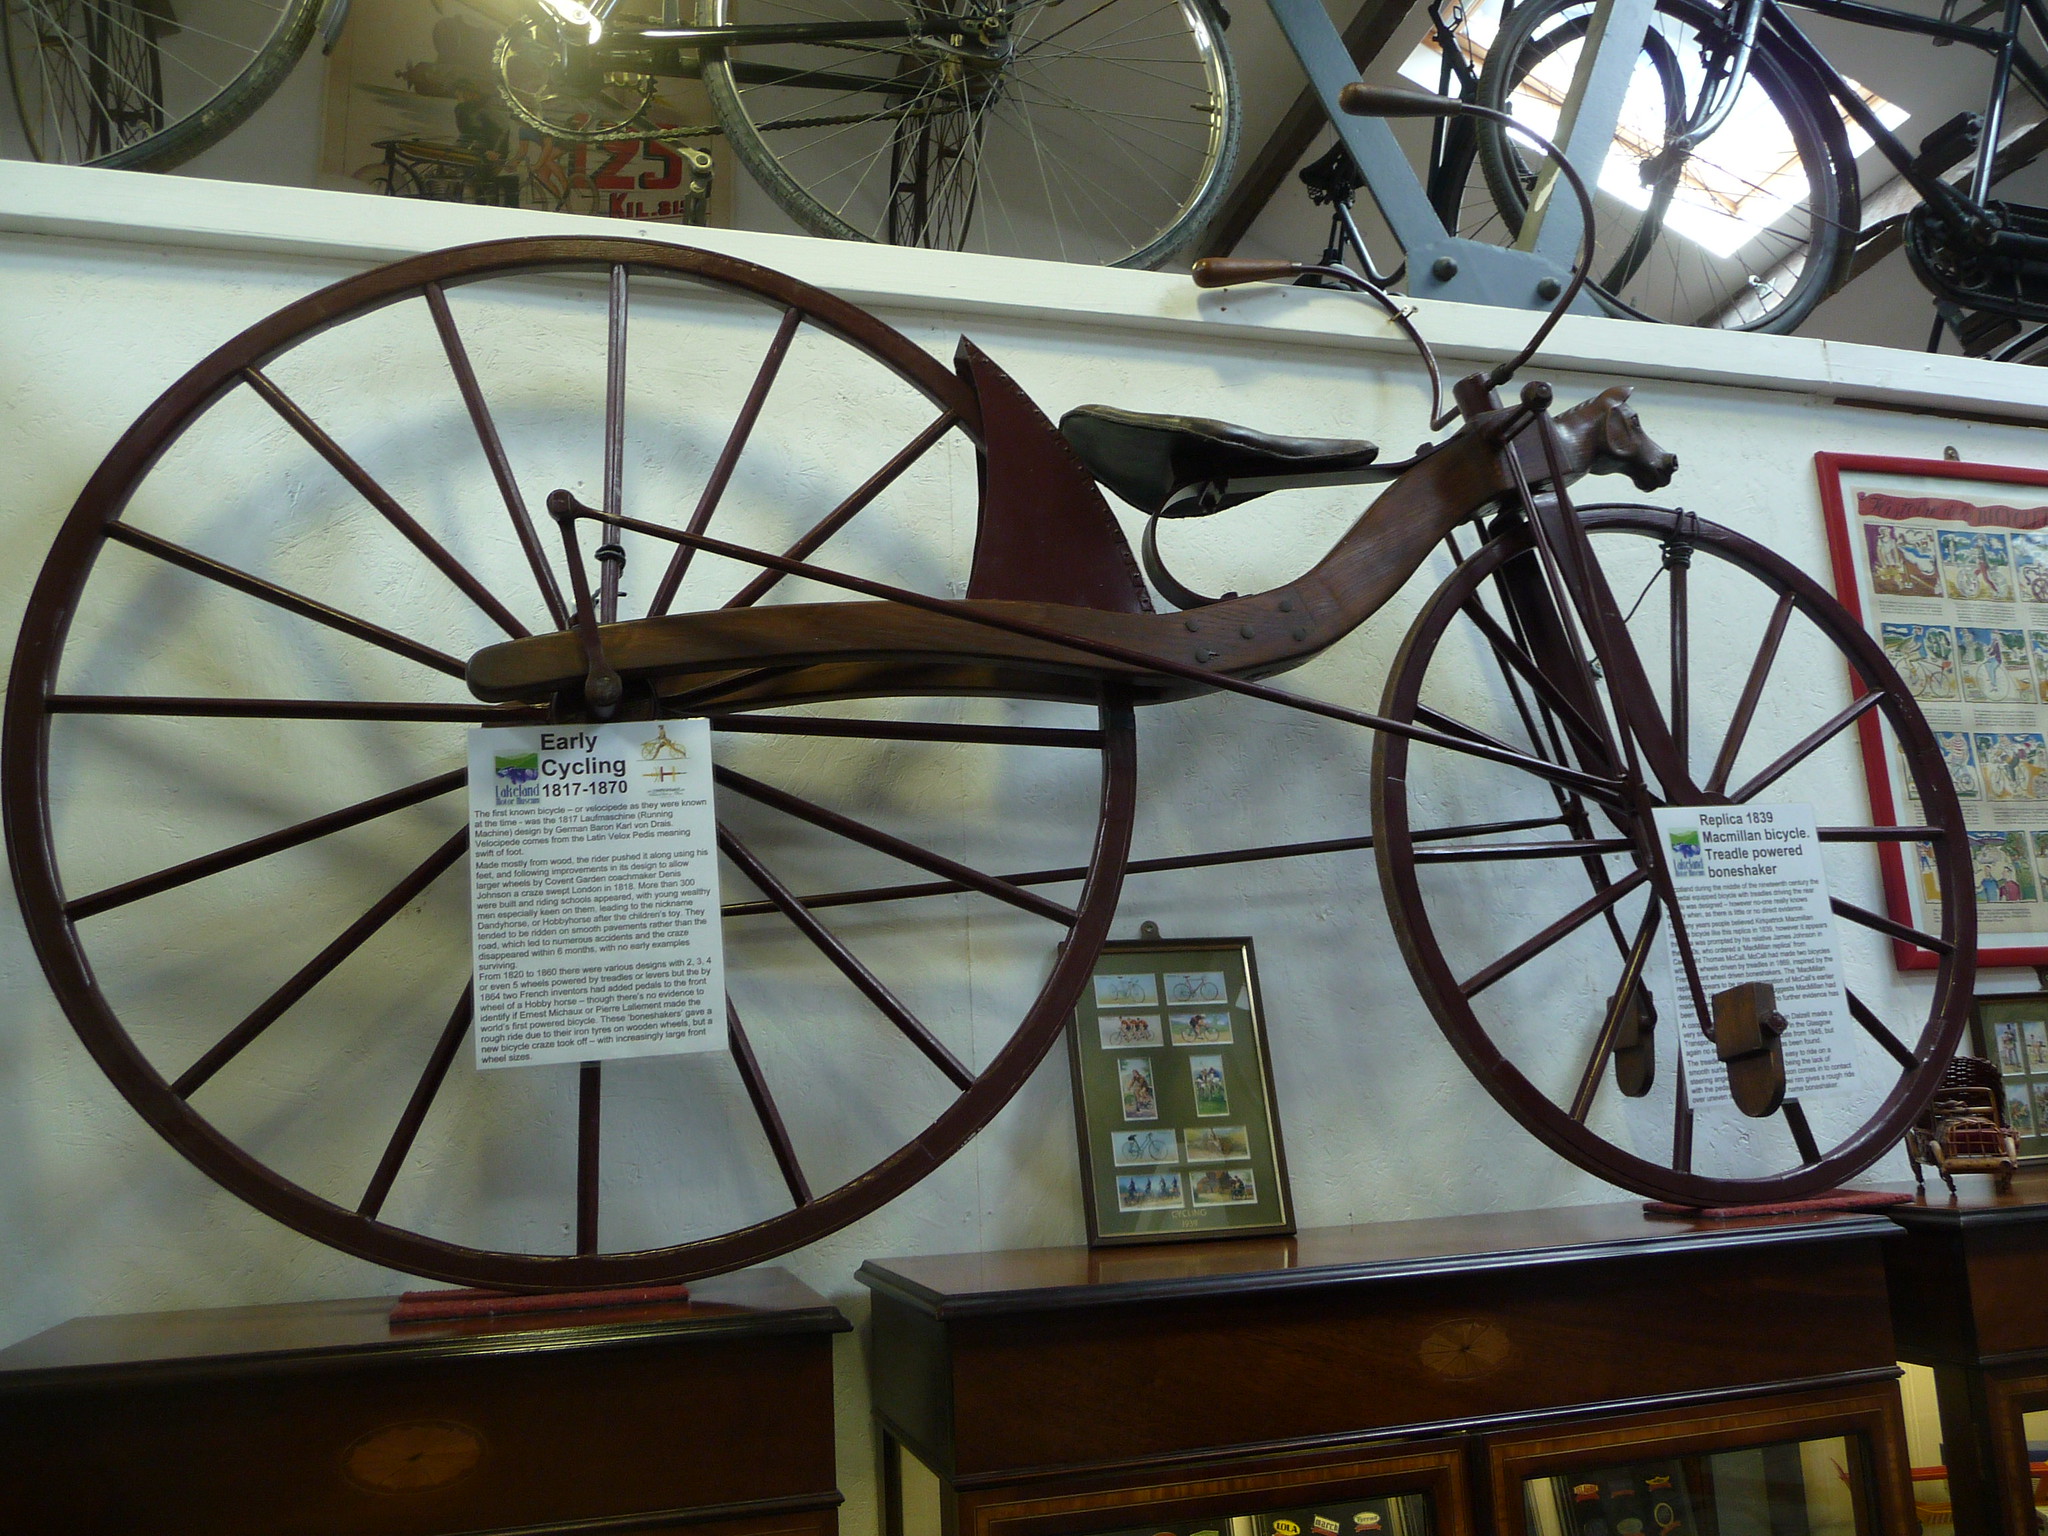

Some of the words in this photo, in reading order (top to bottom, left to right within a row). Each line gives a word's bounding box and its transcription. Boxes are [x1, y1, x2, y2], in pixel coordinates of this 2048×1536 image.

[541, 732, 597, 753] Early
[541, 757, 626, 780] Cycling
[495, 784, 540, 798] Lakeland
[542, 779, 628, 797] 1817-1870
[474, 810, 491, 818] The
[492, 809, 508, 817] first
[537, 806, 566, 816] bicycle
[585, 803, 628, 813] velocipede
[641, 801, 659, 812] they
[681, 799, 707, 807] known
[474, 820, 483, 828] at
[484, 819, 498, 828] the
[499, 818, 518, 827] time
[542, 815, 557, 825] the
[558, 814, 578, 824] 1817
[580, 812, 636, 823] Laufmaschine
[637, 810, 673, 821] (Running
[1700, 814, 1743, 828] Replica
[1746, 812, 1773, 824] 1839
[474, 828, 513, 839] Machine)
[514, 827, 542, 837] design
[543, 826, 554, 836] by
[555, 825, 588, 834] German
[589, 823, 614, 832] Baron
[615, 821, 632, 830] Karl
[474, 838, 521, 849] Velocipede
[522, 837, 550, 846] comes
[551, 835, 570, 844] from
[571, 835, 585, 843] the
[586, 833, 607, 842] Latin
[607, 832, 631, 840] Velox
[632, 830, 655, 839] Pedis
[656, 828, 691, 837] meaning
[1702, 830, 1762, 843] Macmillan
[1765, 827, 1810, 843] bicycle.
[474, 849, 495, 858] swift
[495, 848, 505, 857] of
[475, 861, 499, 870] Made
[500, 859, 528, 869] mostly
[529, 858, 549, 867] from
[576, 856, 590, 864] the
[591, 855, 610, 863] rider
[611, 852, 641, 863] pushed
[642, 852, 648, 860] it
[649, 851, 672, 860] along
[673, 850, 695, 860] using
[696, 848, 709, 856] his
[1705, 847, 1749, 860] Treadle
[1752, 845, 1803, 860] powered
[476, 881, 501, 891] larger
[501, 879, 531, 888] wheels
[532, 878, 543, 888] by
[544, 875, 574, 886] Covent
[575, 874, 606, 884] Garden
[607, 871, 657, 882] coachmaker
[658, 869, 682, 879] Denis
[1708, 864, 1777, 878] boneshaker
[476, 890, 512, 900] Johnson
[520, 889, 544, 897] craze
[545, 887, 570, 897] swept
[571, 883, 603, 894] London
[603, 884, 612, 892] in
[638, 880, 659, 890] More
[660, 879, 678, 889] than
[680, 878, 696, 887] 300
[476, 902, 498, 910] were
[499, 900, 517, 909] built
[518, 898, 534, 907] and
[536, 896, 559, 908] riding
[560, 895, 592, 905] schools
[635, 891, 653, 900] with
[654, 891, 679, 901] young
[680, 888, 711, 897] wealthy
[531, 919, 541, 927] or
[542, 916, 592, 927] Hobbyhorse
[593, 914, 612, 923] after
[613, 913, 627, 921] the
[628, 910, 667, 920] children's
[684, 908, 705, 918] They
[478, 972, 501, 981] From
[503, 970, 525, 979] 1820
[525, 970, 535, 978] to
[536, 967, 558, 977] 1860
[559, 967, 581, 976] there
[581, 966, 602, 974] were
[604, 963, 634, 972] various
[635, 961, 667, 971] designs
[668, 959, 685, 967] with
[705, 956, 712, 964] 4
[480, 992, 501, 1002] 1864
[502, 992, 518, 1000] two
[519, 988, 549, 999] French
[550, 987, 589, 996] inventors
[590, 984, 606, 993] had
[607, 982, 633, 992] added
[635, 980, 662, 992] pedals
[663, 980, 672, 988] to
[673, 978, 687, 987] the
[688, 977, 707, 986] front
[481, 1054, 507, 1064] wheel
[1276, 1522, 1298, 1534] LOLA
